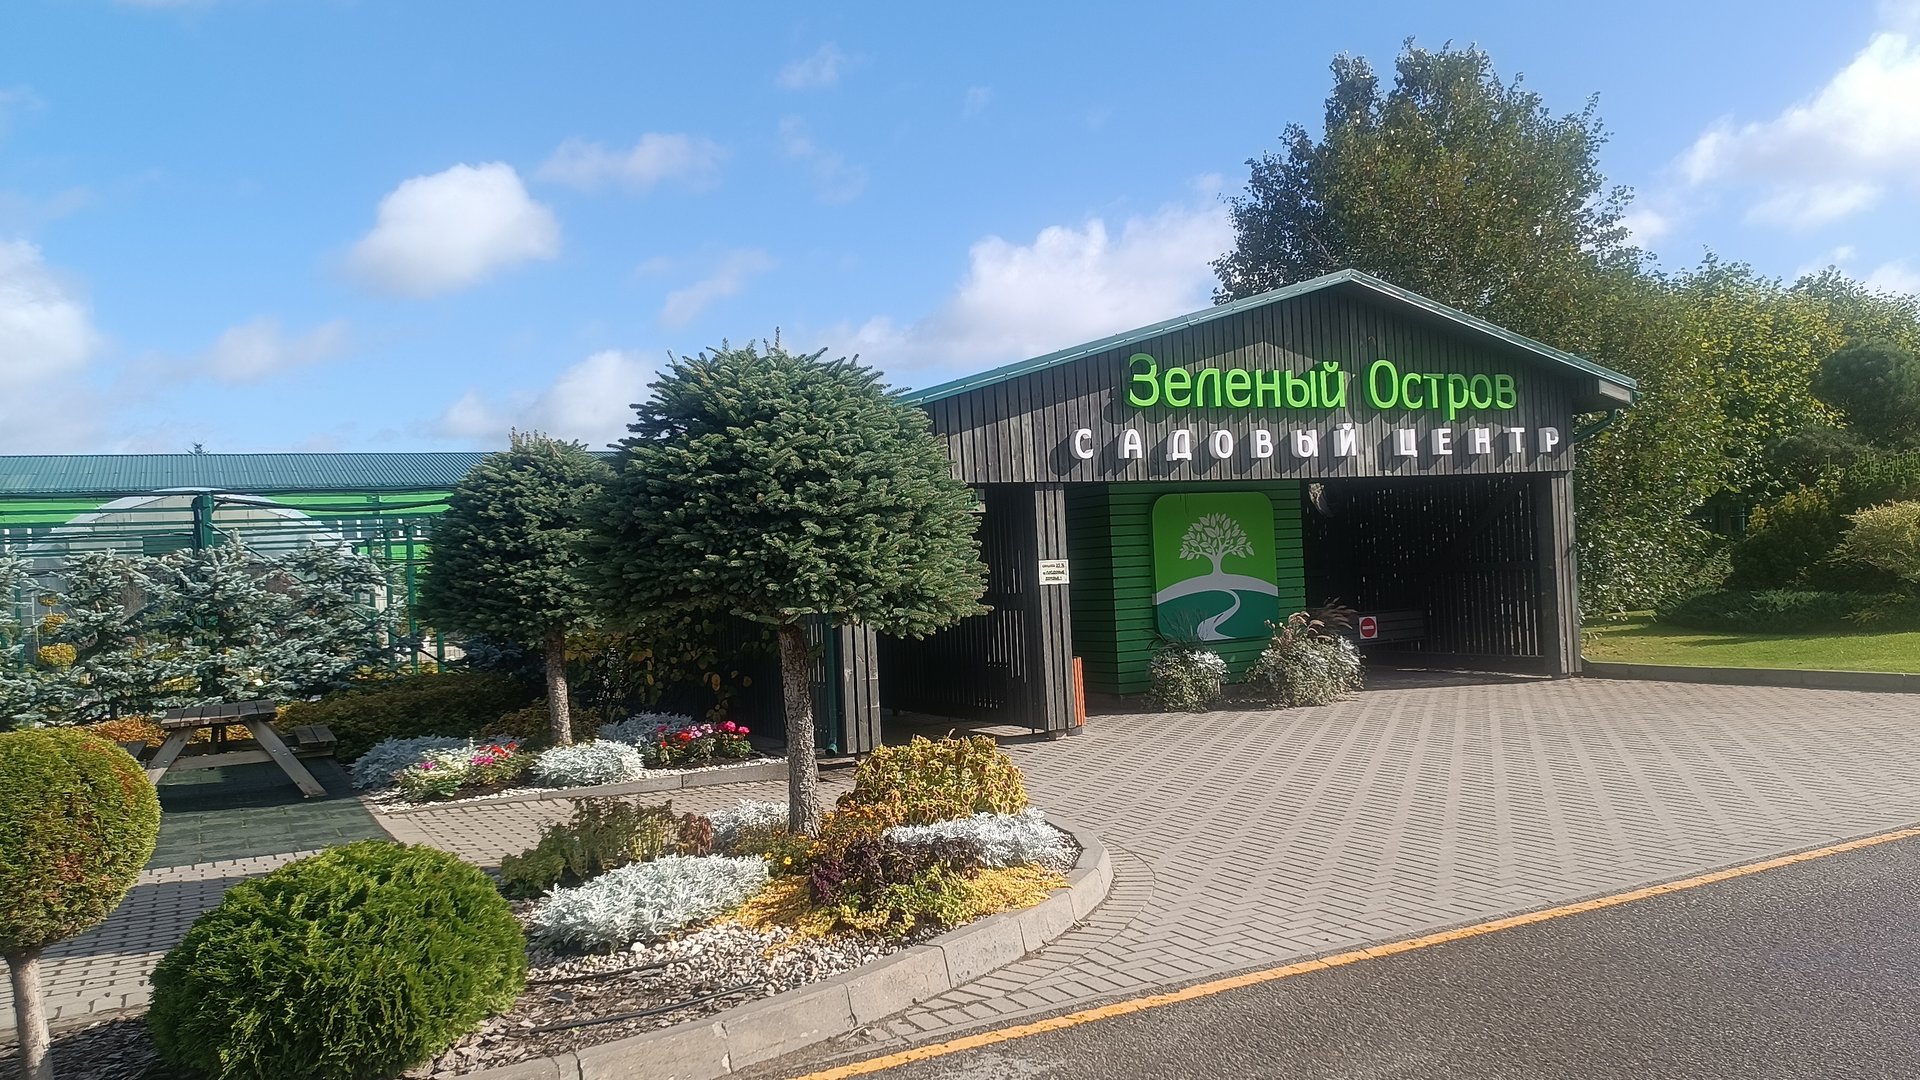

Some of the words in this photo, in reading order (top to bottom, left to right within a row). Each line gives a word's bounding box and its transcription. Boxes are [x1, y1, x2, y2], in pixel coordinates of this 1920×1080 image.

[1129, 353, 1346, 408] Зеленый
[1369, 359, 1518, 421] Остров
[1072, 423, 1357, 461] САДОВЫЙ
[1397, 426, 1560, 458] ЦЕНТР
